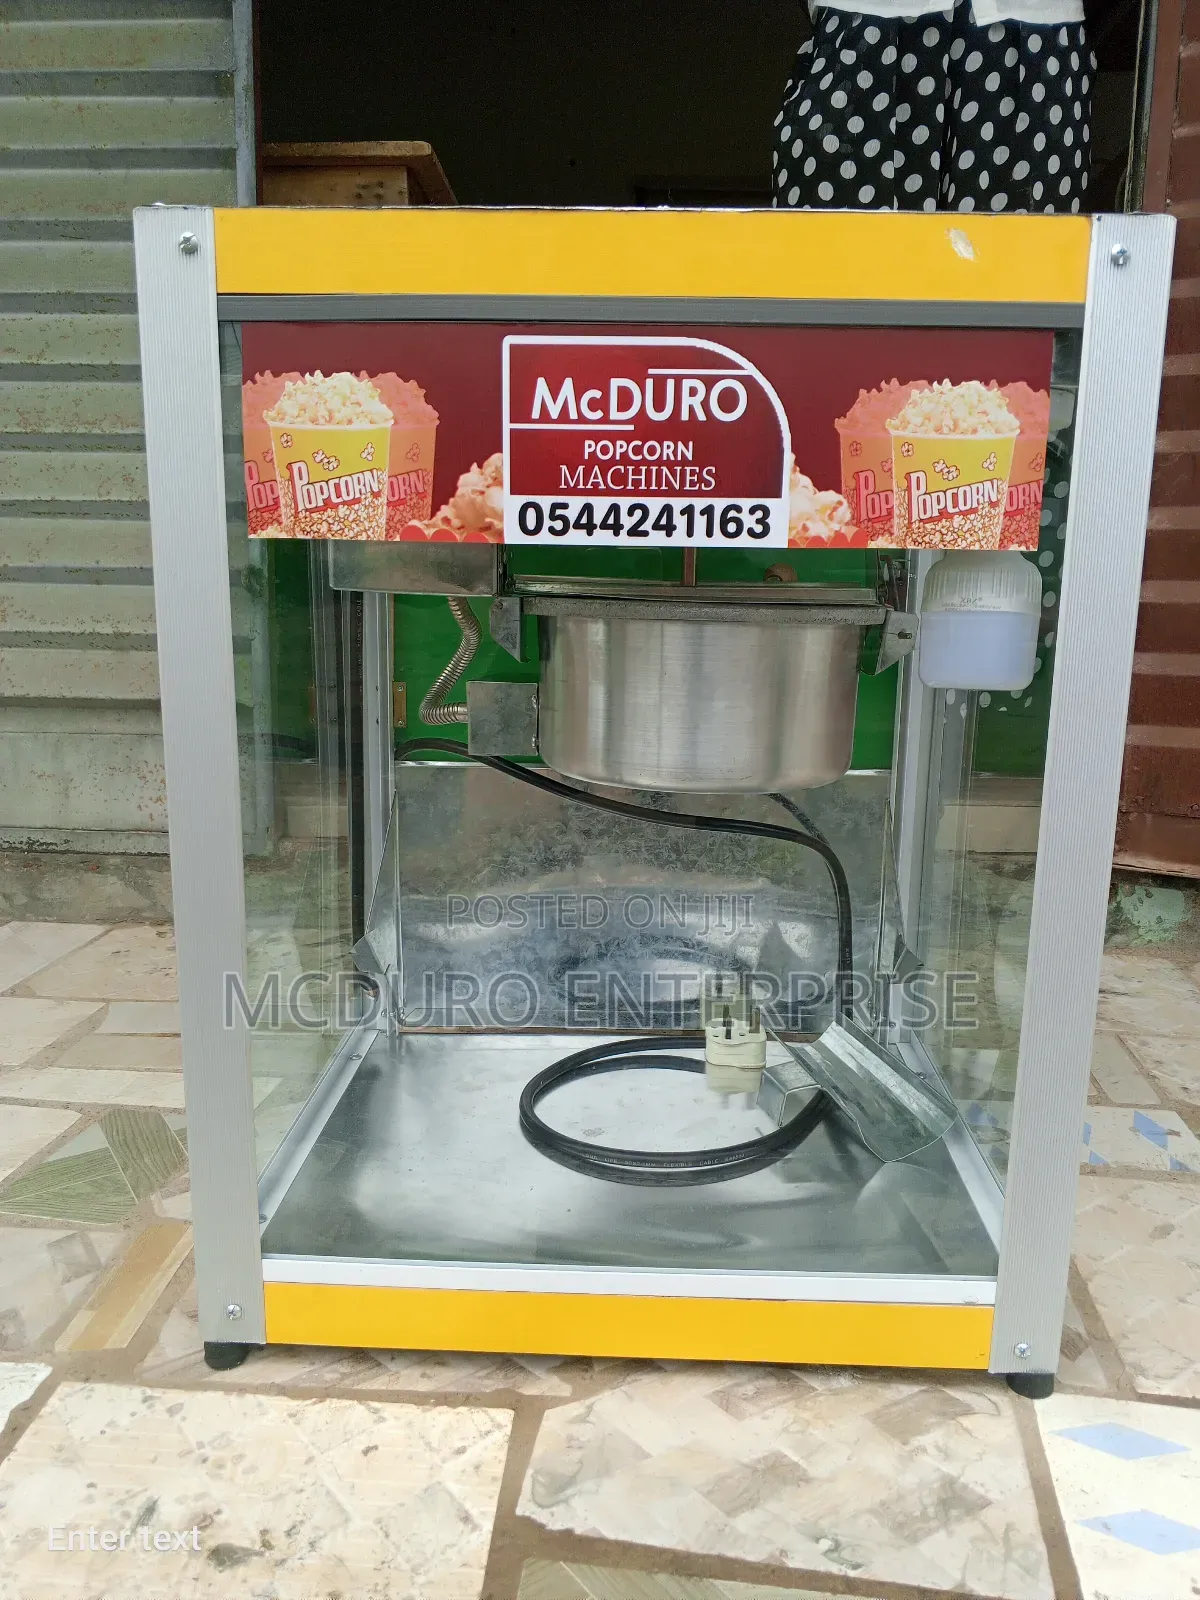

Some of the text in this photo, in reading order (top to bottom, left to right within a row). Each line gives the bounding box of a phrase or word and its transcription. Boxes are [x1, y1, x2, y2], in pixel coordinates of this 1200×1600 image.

[531, 377, 748, 422] McDURO
[584, 440, 693, 461] POPCORN
[288, 460, 381, 511] POPCORN
[559, 465, 716, 491] MACHINES
[908, 471, 1000, 521] POPCORN
[518, 501, 771, 540] 0544241163
